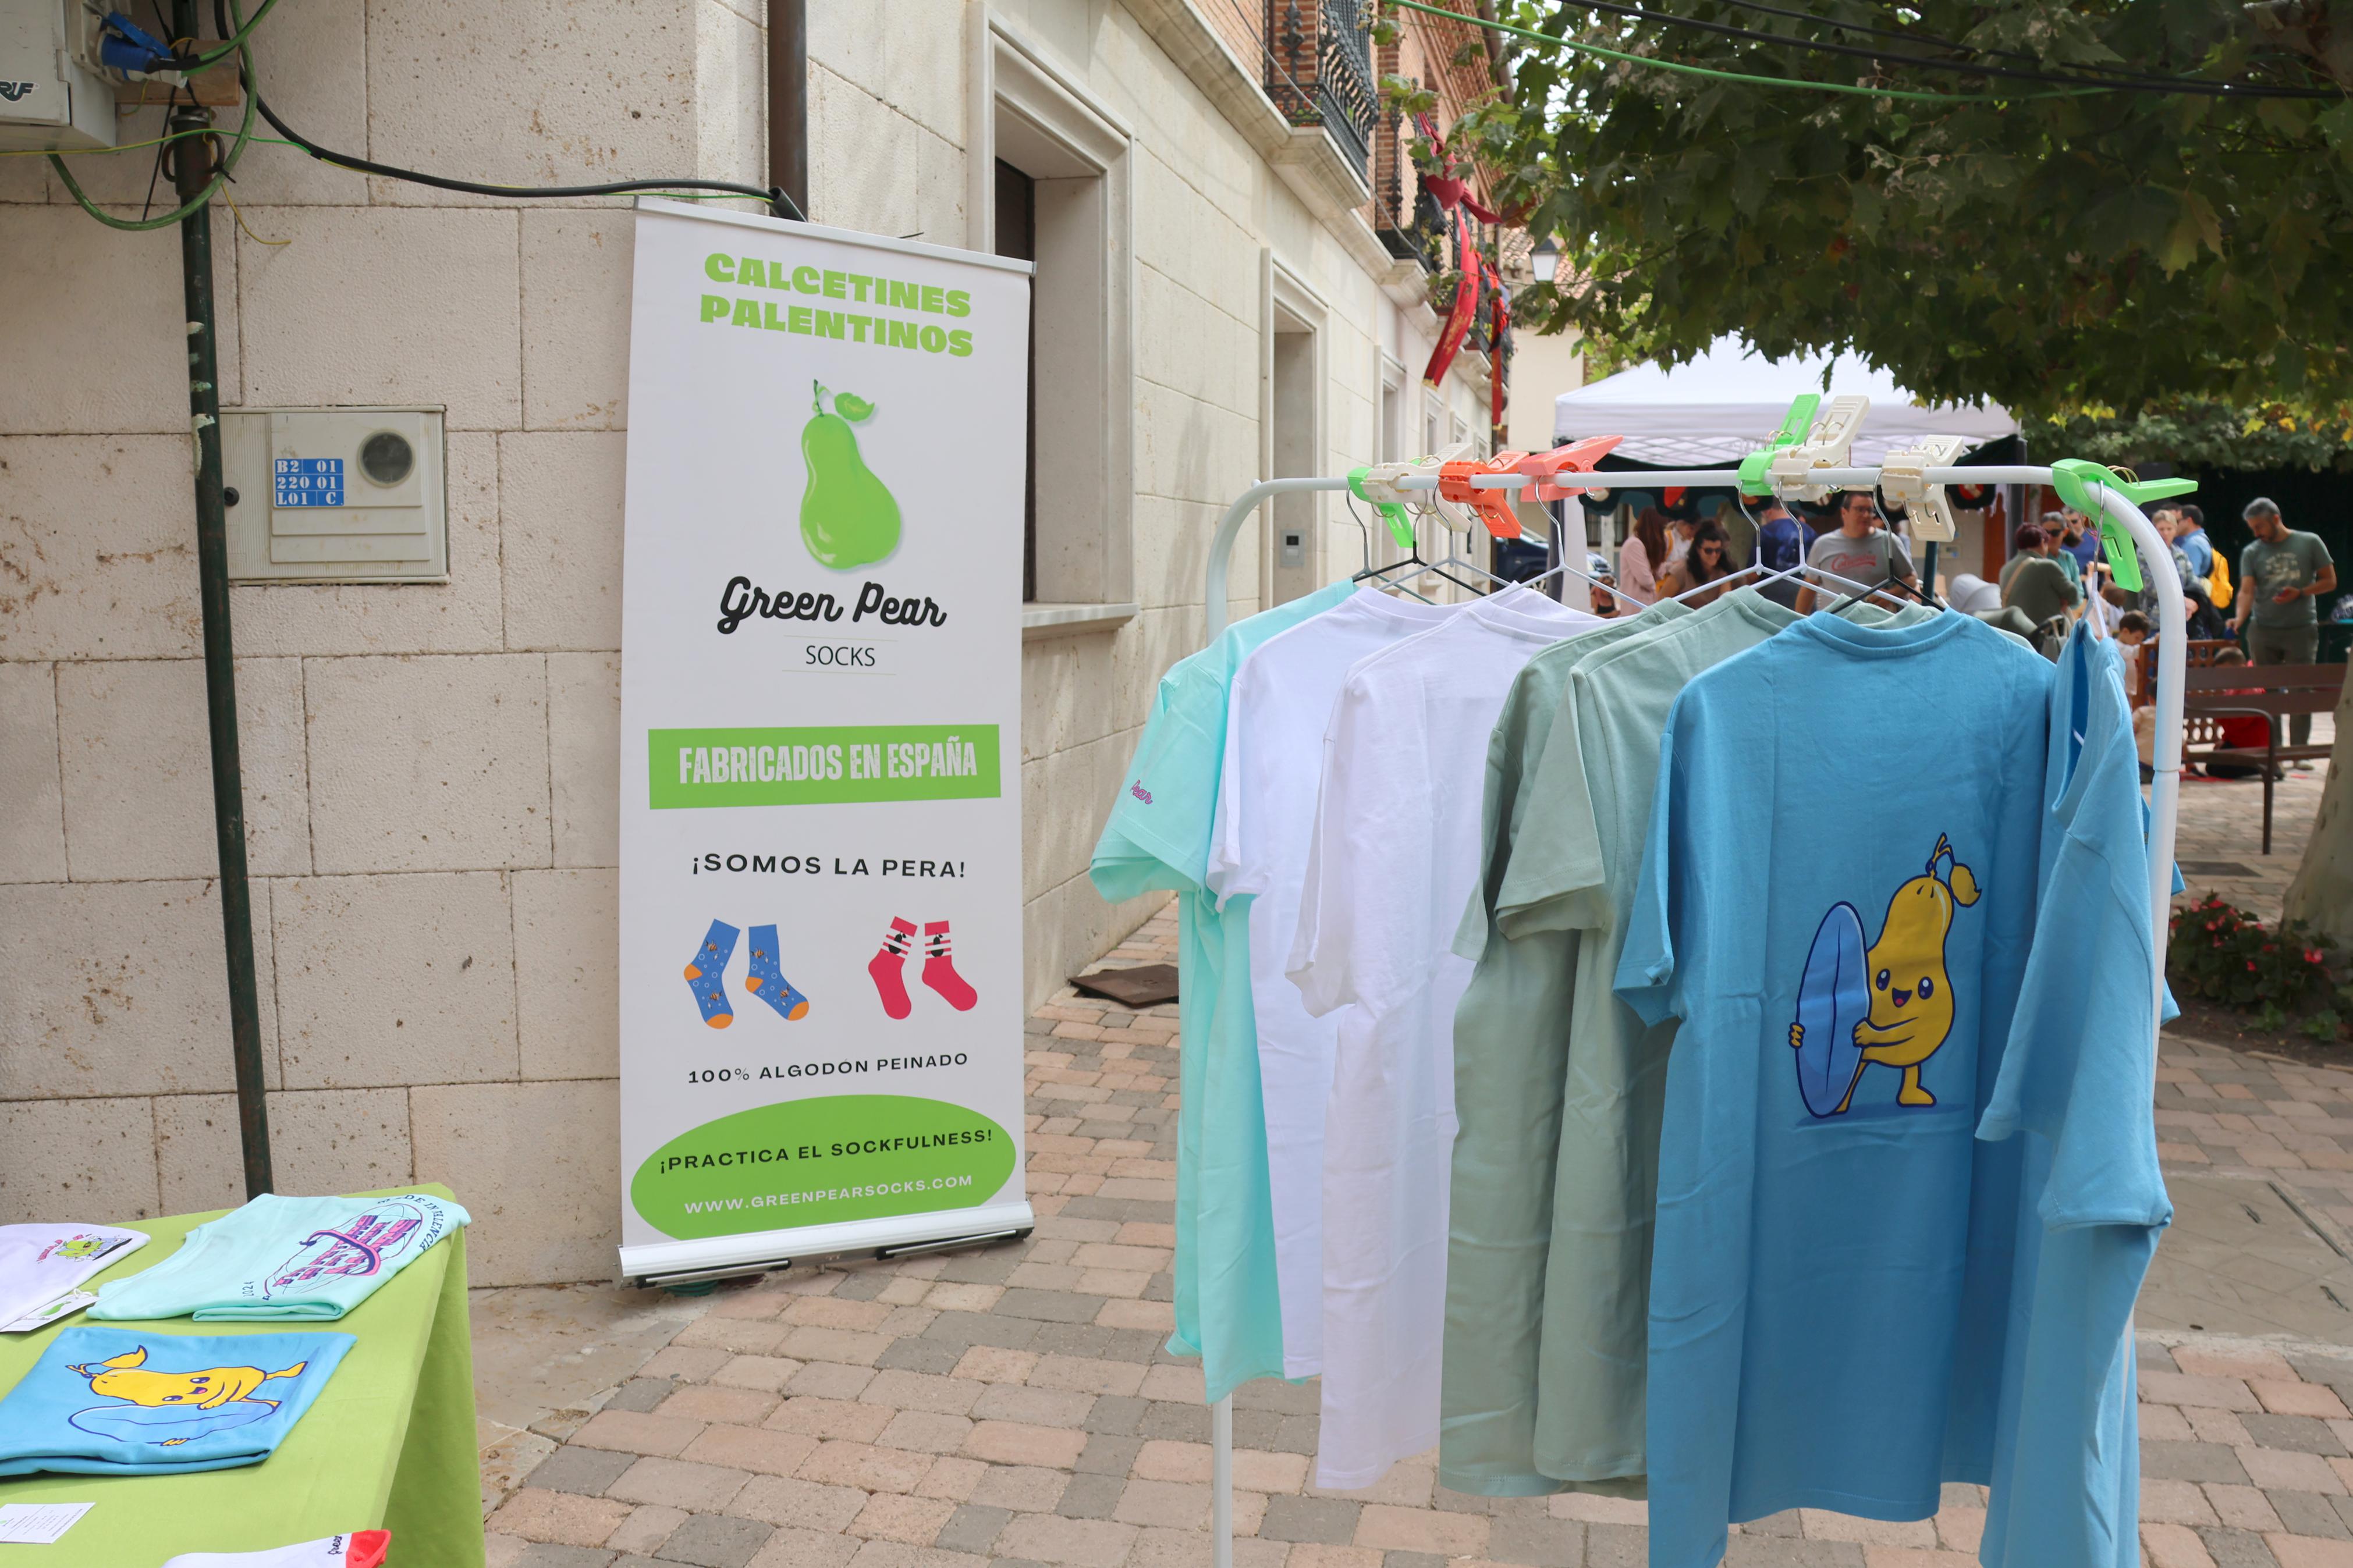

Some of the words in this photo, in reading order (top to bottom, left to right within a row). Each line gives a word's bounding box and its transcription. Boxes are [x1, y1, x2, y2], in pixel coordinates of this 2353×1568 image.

[704, 253, 971, 318] CALCETINES
[700, 294, 973, 357] PALENTINOS
[276, 460, 300, 473] B2
[316, 460, 336, 473] 01
[276, 476, 310, 489] 220
[317, 476, 336, 489] 01
[277, 492, 308, 505] L01
[325, 491, 336, 505] C
[716, 575, 844, 635] Green
[852, 581, 947, 627] Pear
[805, 645, 876, 667] SOCKS
[679, 744, 843, 784] FABRICADOS
[850, 744, 881, 779] EN
[887, 735, 978, 778] ESPAÑA
[693, 852, 822, 875] ¡SOMOS
[834, 858, 869, 876] LA
[882, 859, 965, 878] PERA!
[688, 1068, 750, 1084] 100%
[877, 1053, 968, 1071] PEINADO
[660, 1147, 789, 1175] ¡PRACTICA
[798, 1145, 822, 1160] EL
[831, 1129, 993, 1157] SOCKFULNESS!
[684, 1175, 973, 1214] WWW.GREENPEARSOCKS.COM
